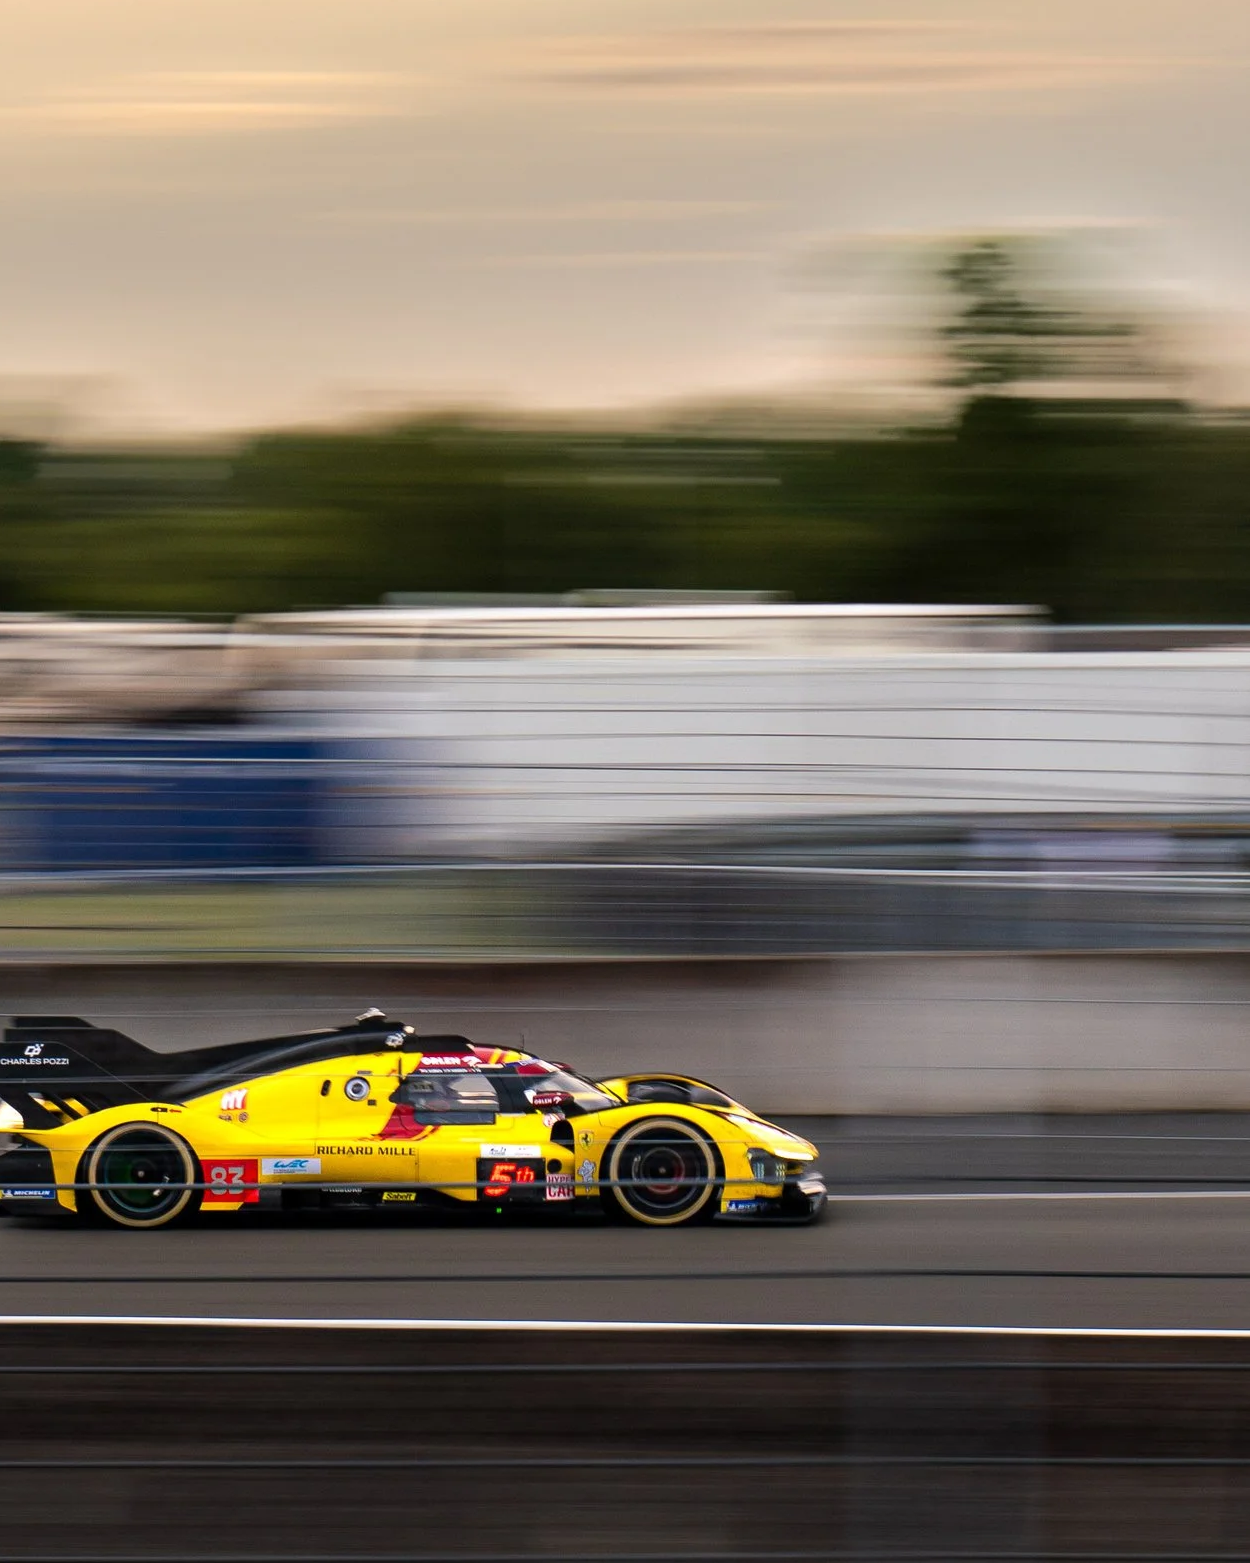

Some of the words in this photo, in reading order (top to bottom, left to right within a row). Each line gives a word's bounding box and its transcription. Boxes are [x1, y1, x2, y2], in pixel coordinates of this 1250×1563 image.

[420, 1056, 461, 1066] ORLEN
[317, 1146, 373, 1156] RICHARD
[378, 1146, 416, 1156] MILLE
[273, 1159, 309, 1169] WEC
[211, 1166, 245, 1195] 83
[484, 1162, 535, 1197] 5th
[548, 1184, 575, 1198] CAR
